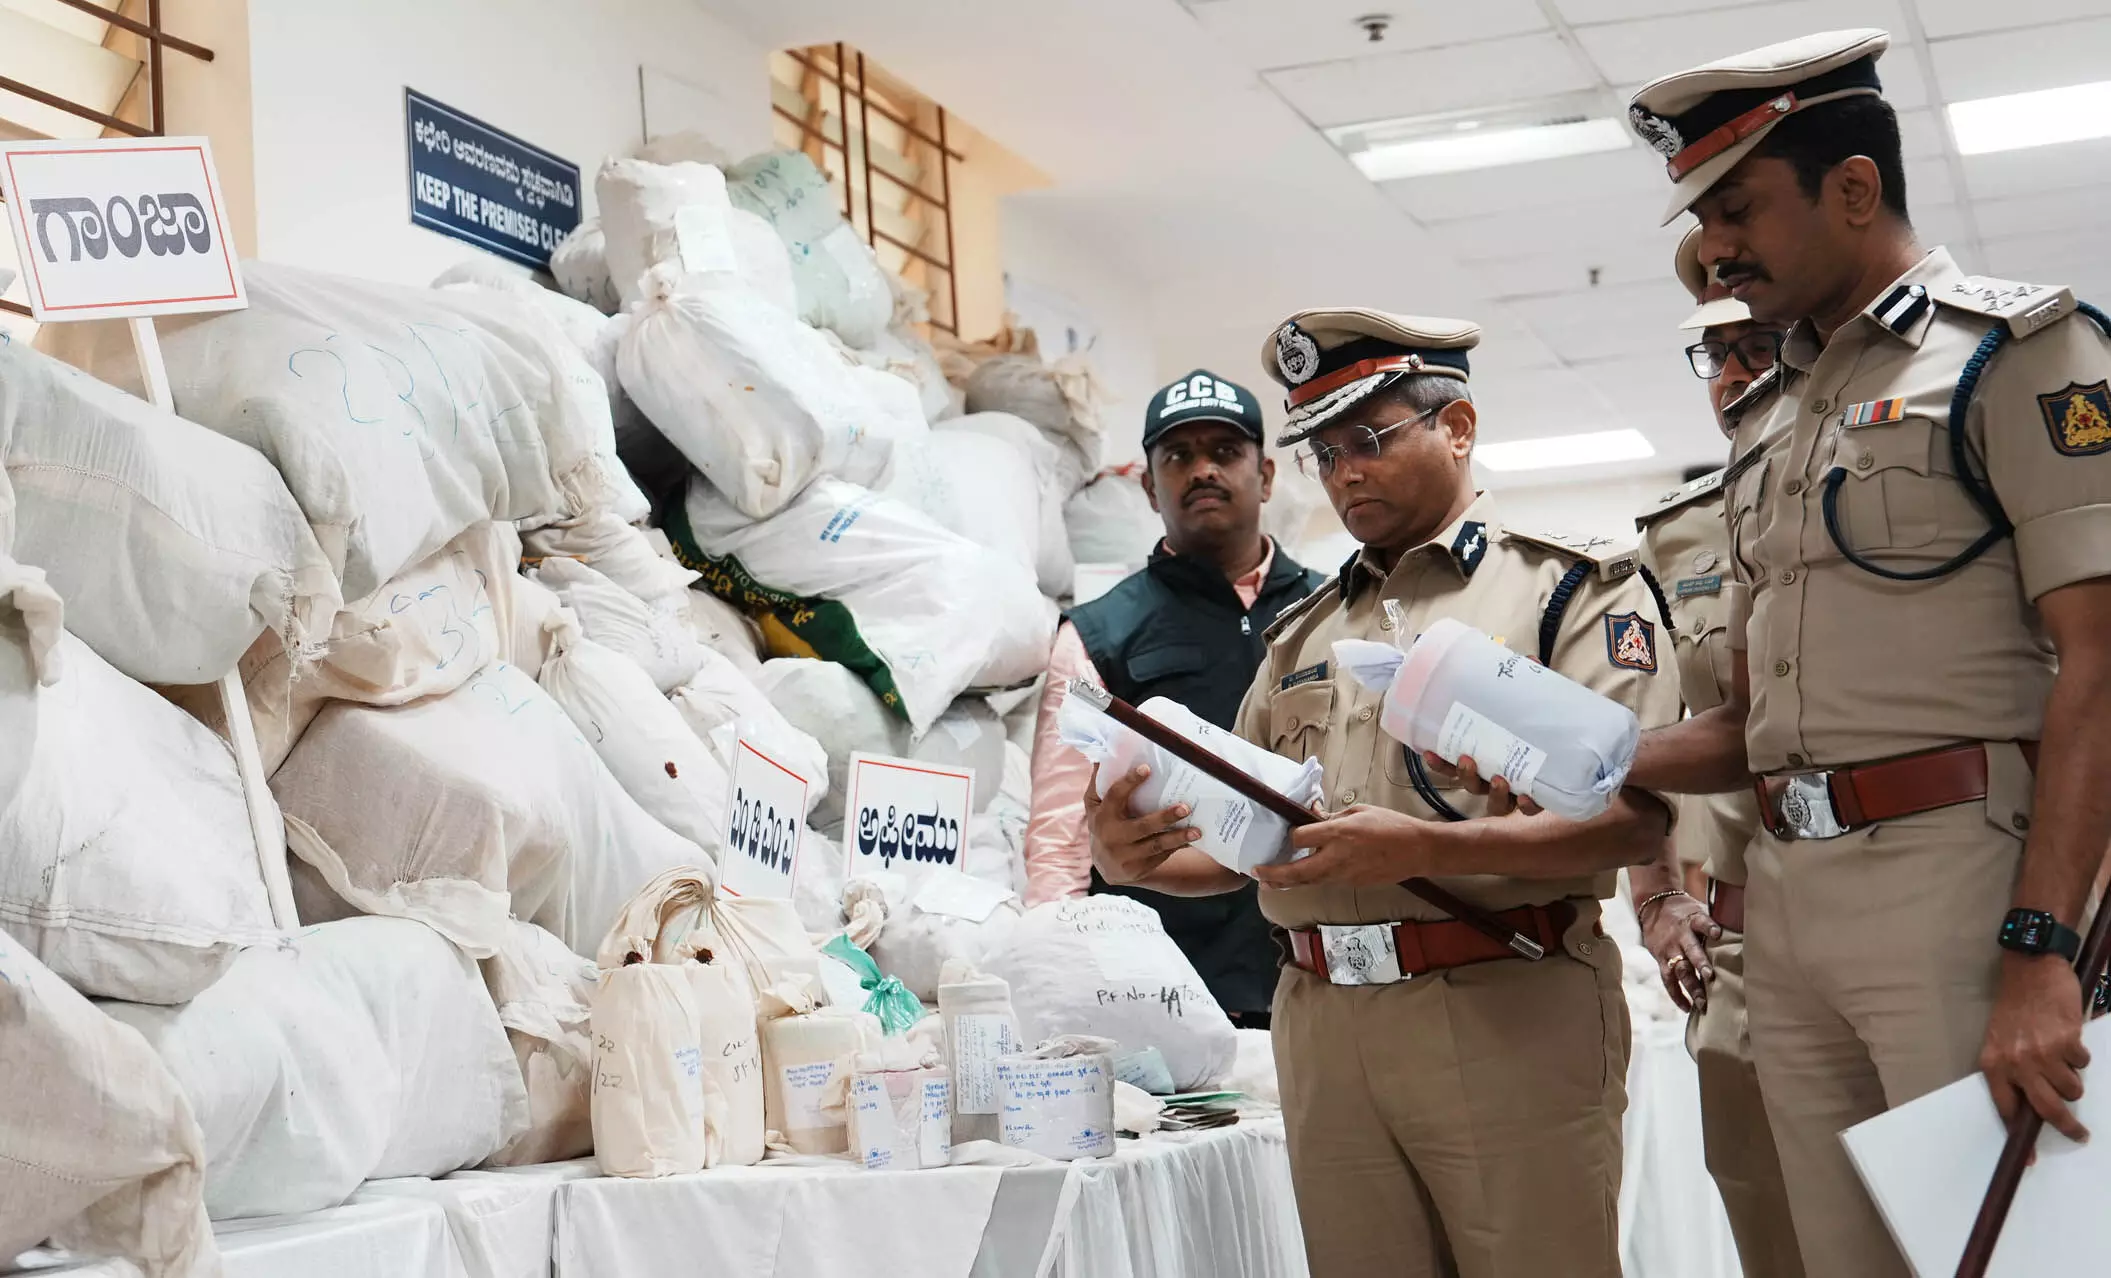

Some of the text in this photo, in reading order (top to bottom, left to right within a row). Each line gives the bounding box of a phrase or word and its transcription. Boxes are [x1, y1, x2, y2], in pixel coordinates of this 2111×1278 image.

[29, 193, 211, 263] ಗಾಂಜಾ
[416, 171, 570, 250] KEEP THE PREMISES CLE
[1165, 375, 1238, 406] CCB
[858, 800, 959, 869] ಅಫೀಮು
